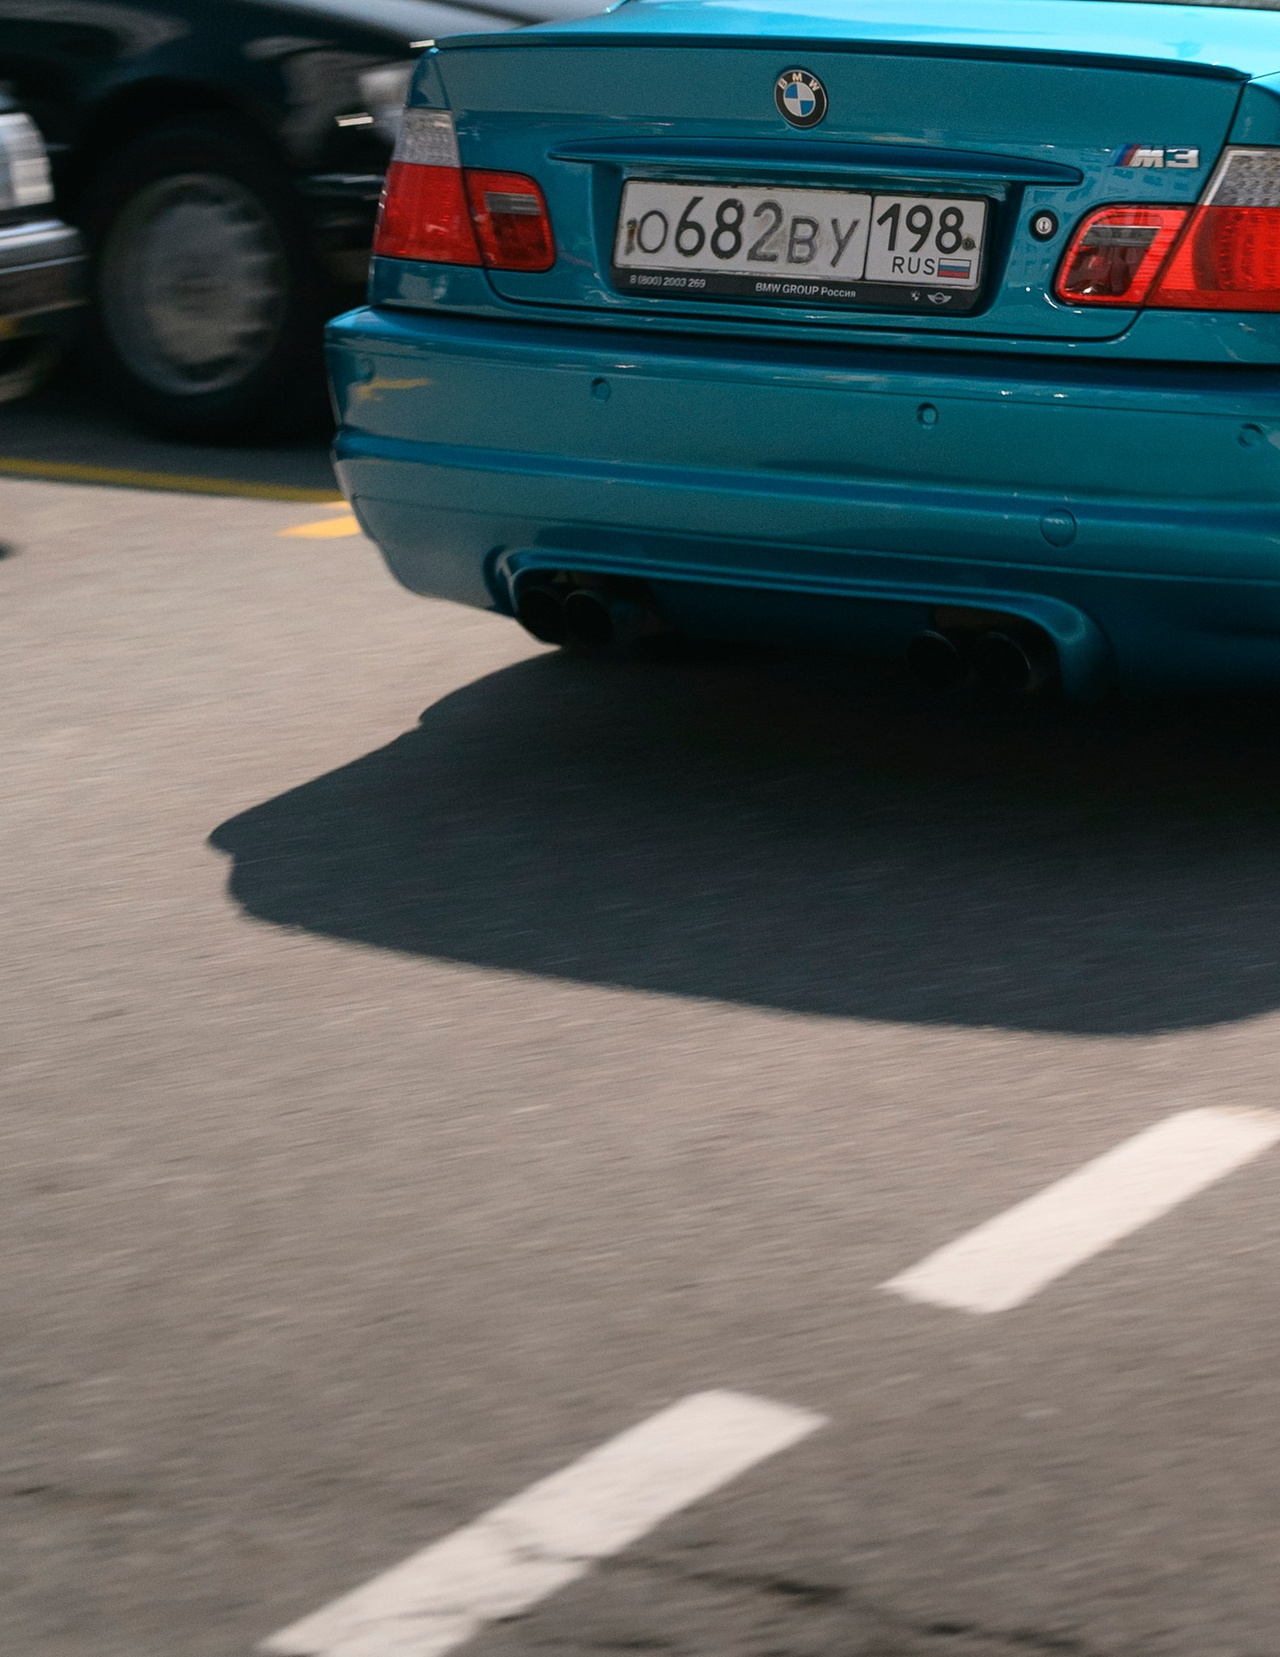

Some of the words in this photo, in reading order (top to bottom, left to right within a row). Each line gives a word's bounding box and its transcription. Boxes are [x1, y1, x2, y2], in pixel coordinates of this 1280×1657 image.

[778, 72, 820, 91] BMW
[876, 203, 964, 254] 198
[892, 256, 935, 275] RUS
[629, 274, 637, 284] 8
[755, 282, 782, 294] BMW
[782, 284, 819, 296] GROUP
[820, 286, 857, 299] Россия
